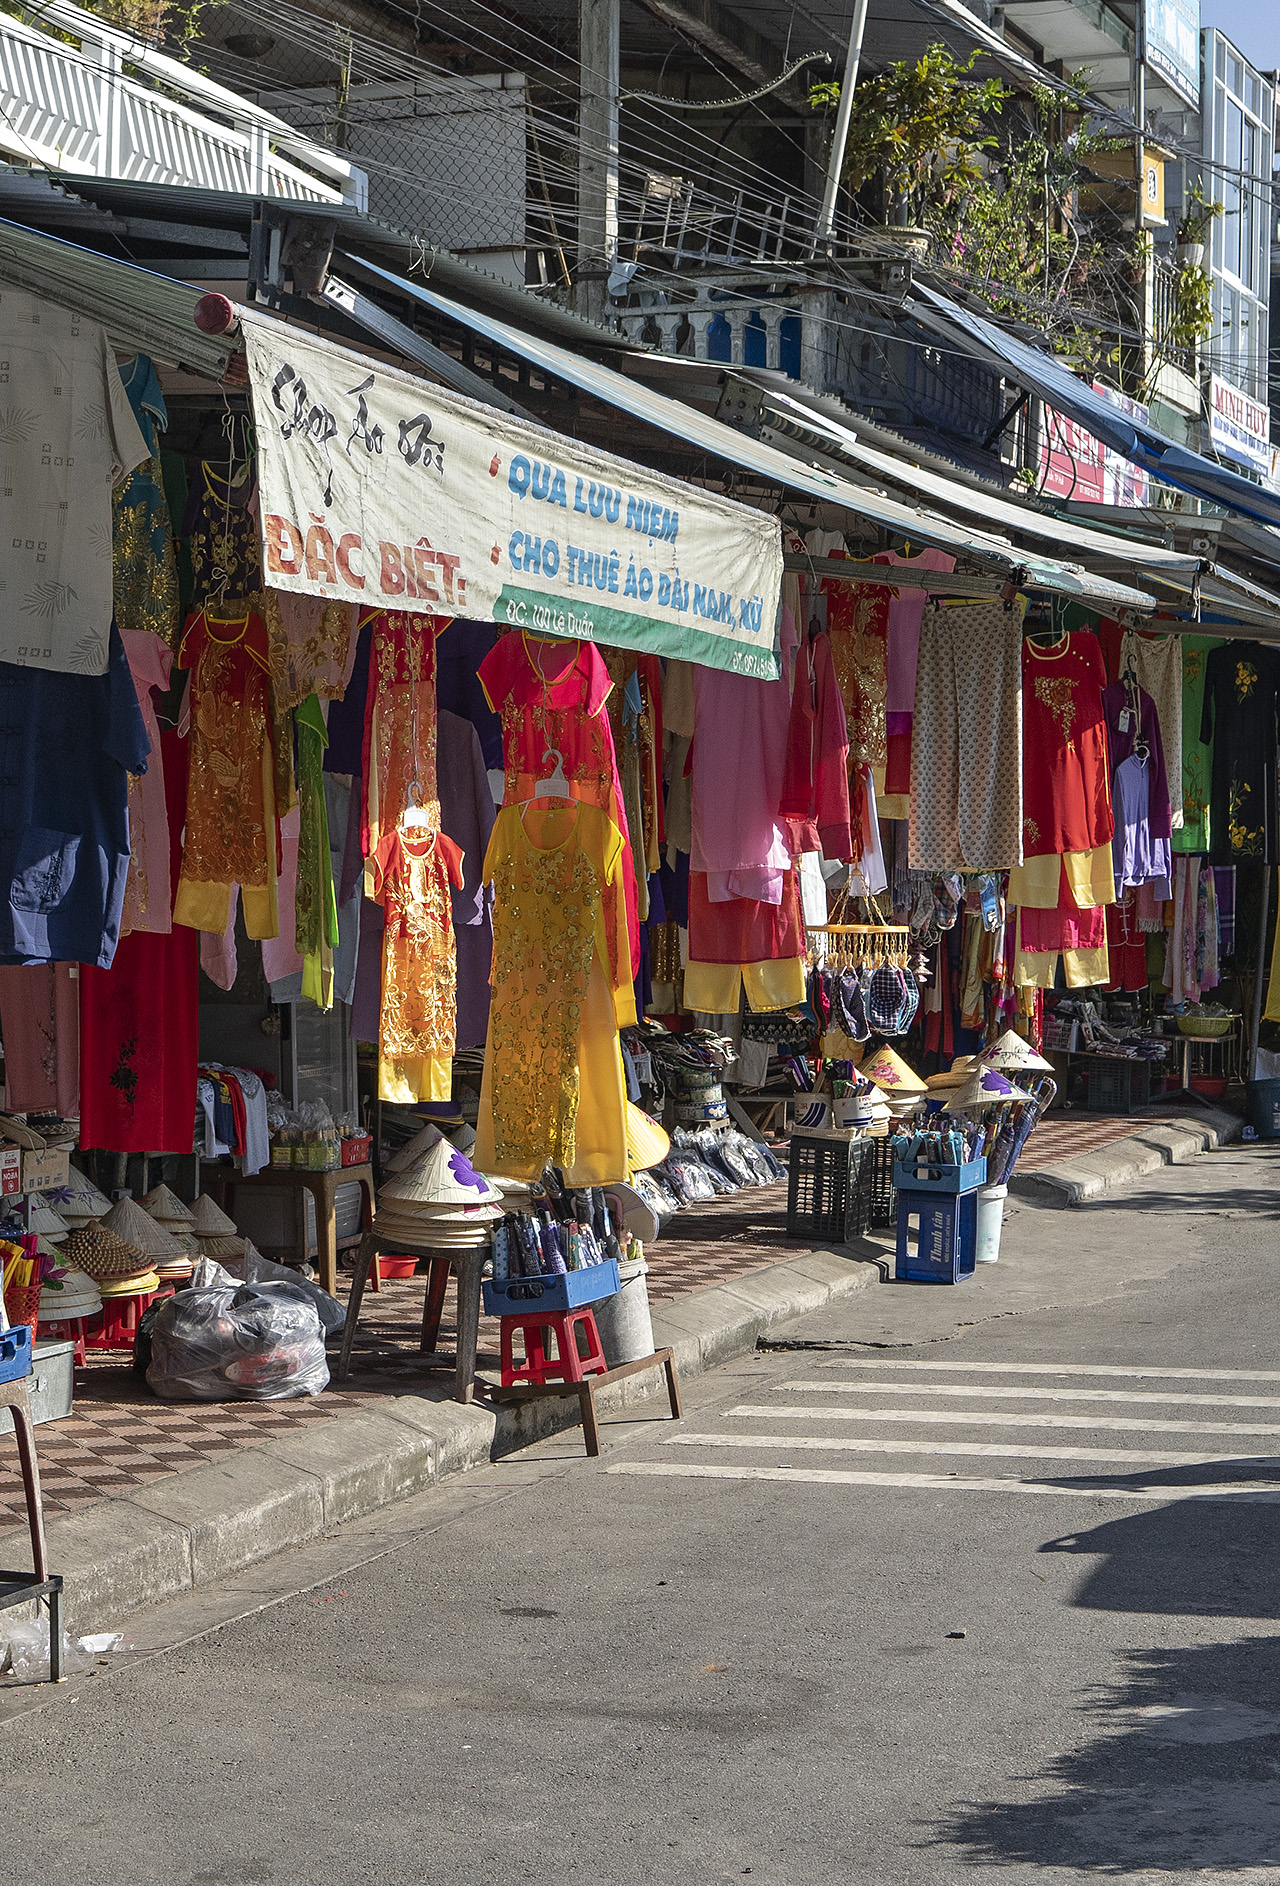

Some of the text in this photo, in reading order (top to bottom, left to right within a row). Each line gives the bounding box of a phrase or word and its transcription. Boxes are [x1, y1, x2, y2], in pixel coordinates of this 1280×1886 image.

[344, 373, 386, 457] Áo
[1215, 384, 1244, 424] MINH
[1246, 402, 1267, 437] HUY
[264, 512, 467, 614] ĐẶC BIỆT:
[508, 530, 560, 578] CHO
[566, 549, 620, 594] THUÊ
[623, 553, 653, 602] ÁO
[658, 567, 690, 613] DÀI
[693, 583, 737, 633] NAM,
[506, 600, 529, 626] ĐC:
[532, 604, 551, 629] 100
[553, 608, 566, 633] Lê
[3, 1172, 18, 1181] VIFON
[930, 1230, 943, 1263] Thanh
